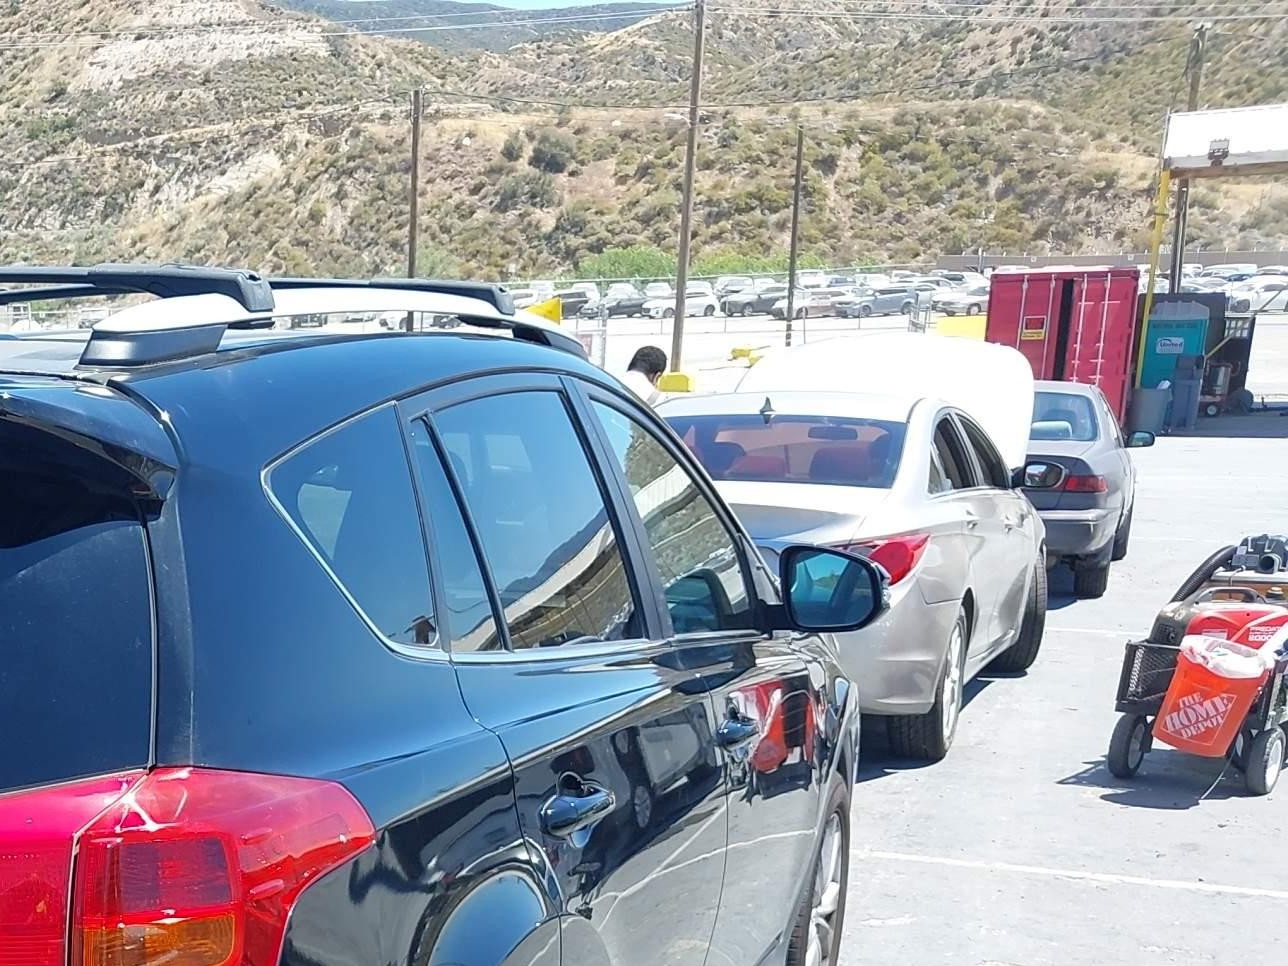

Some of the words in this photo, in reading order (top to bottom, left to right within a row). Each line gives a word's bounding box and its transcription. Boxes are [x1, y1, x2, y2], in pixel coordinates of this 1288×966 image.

[1179, 692, 1203, 708] THE
[1165, 695, 1232, 732] HOME
[1180, 713, 1225, 738] DEPOT
